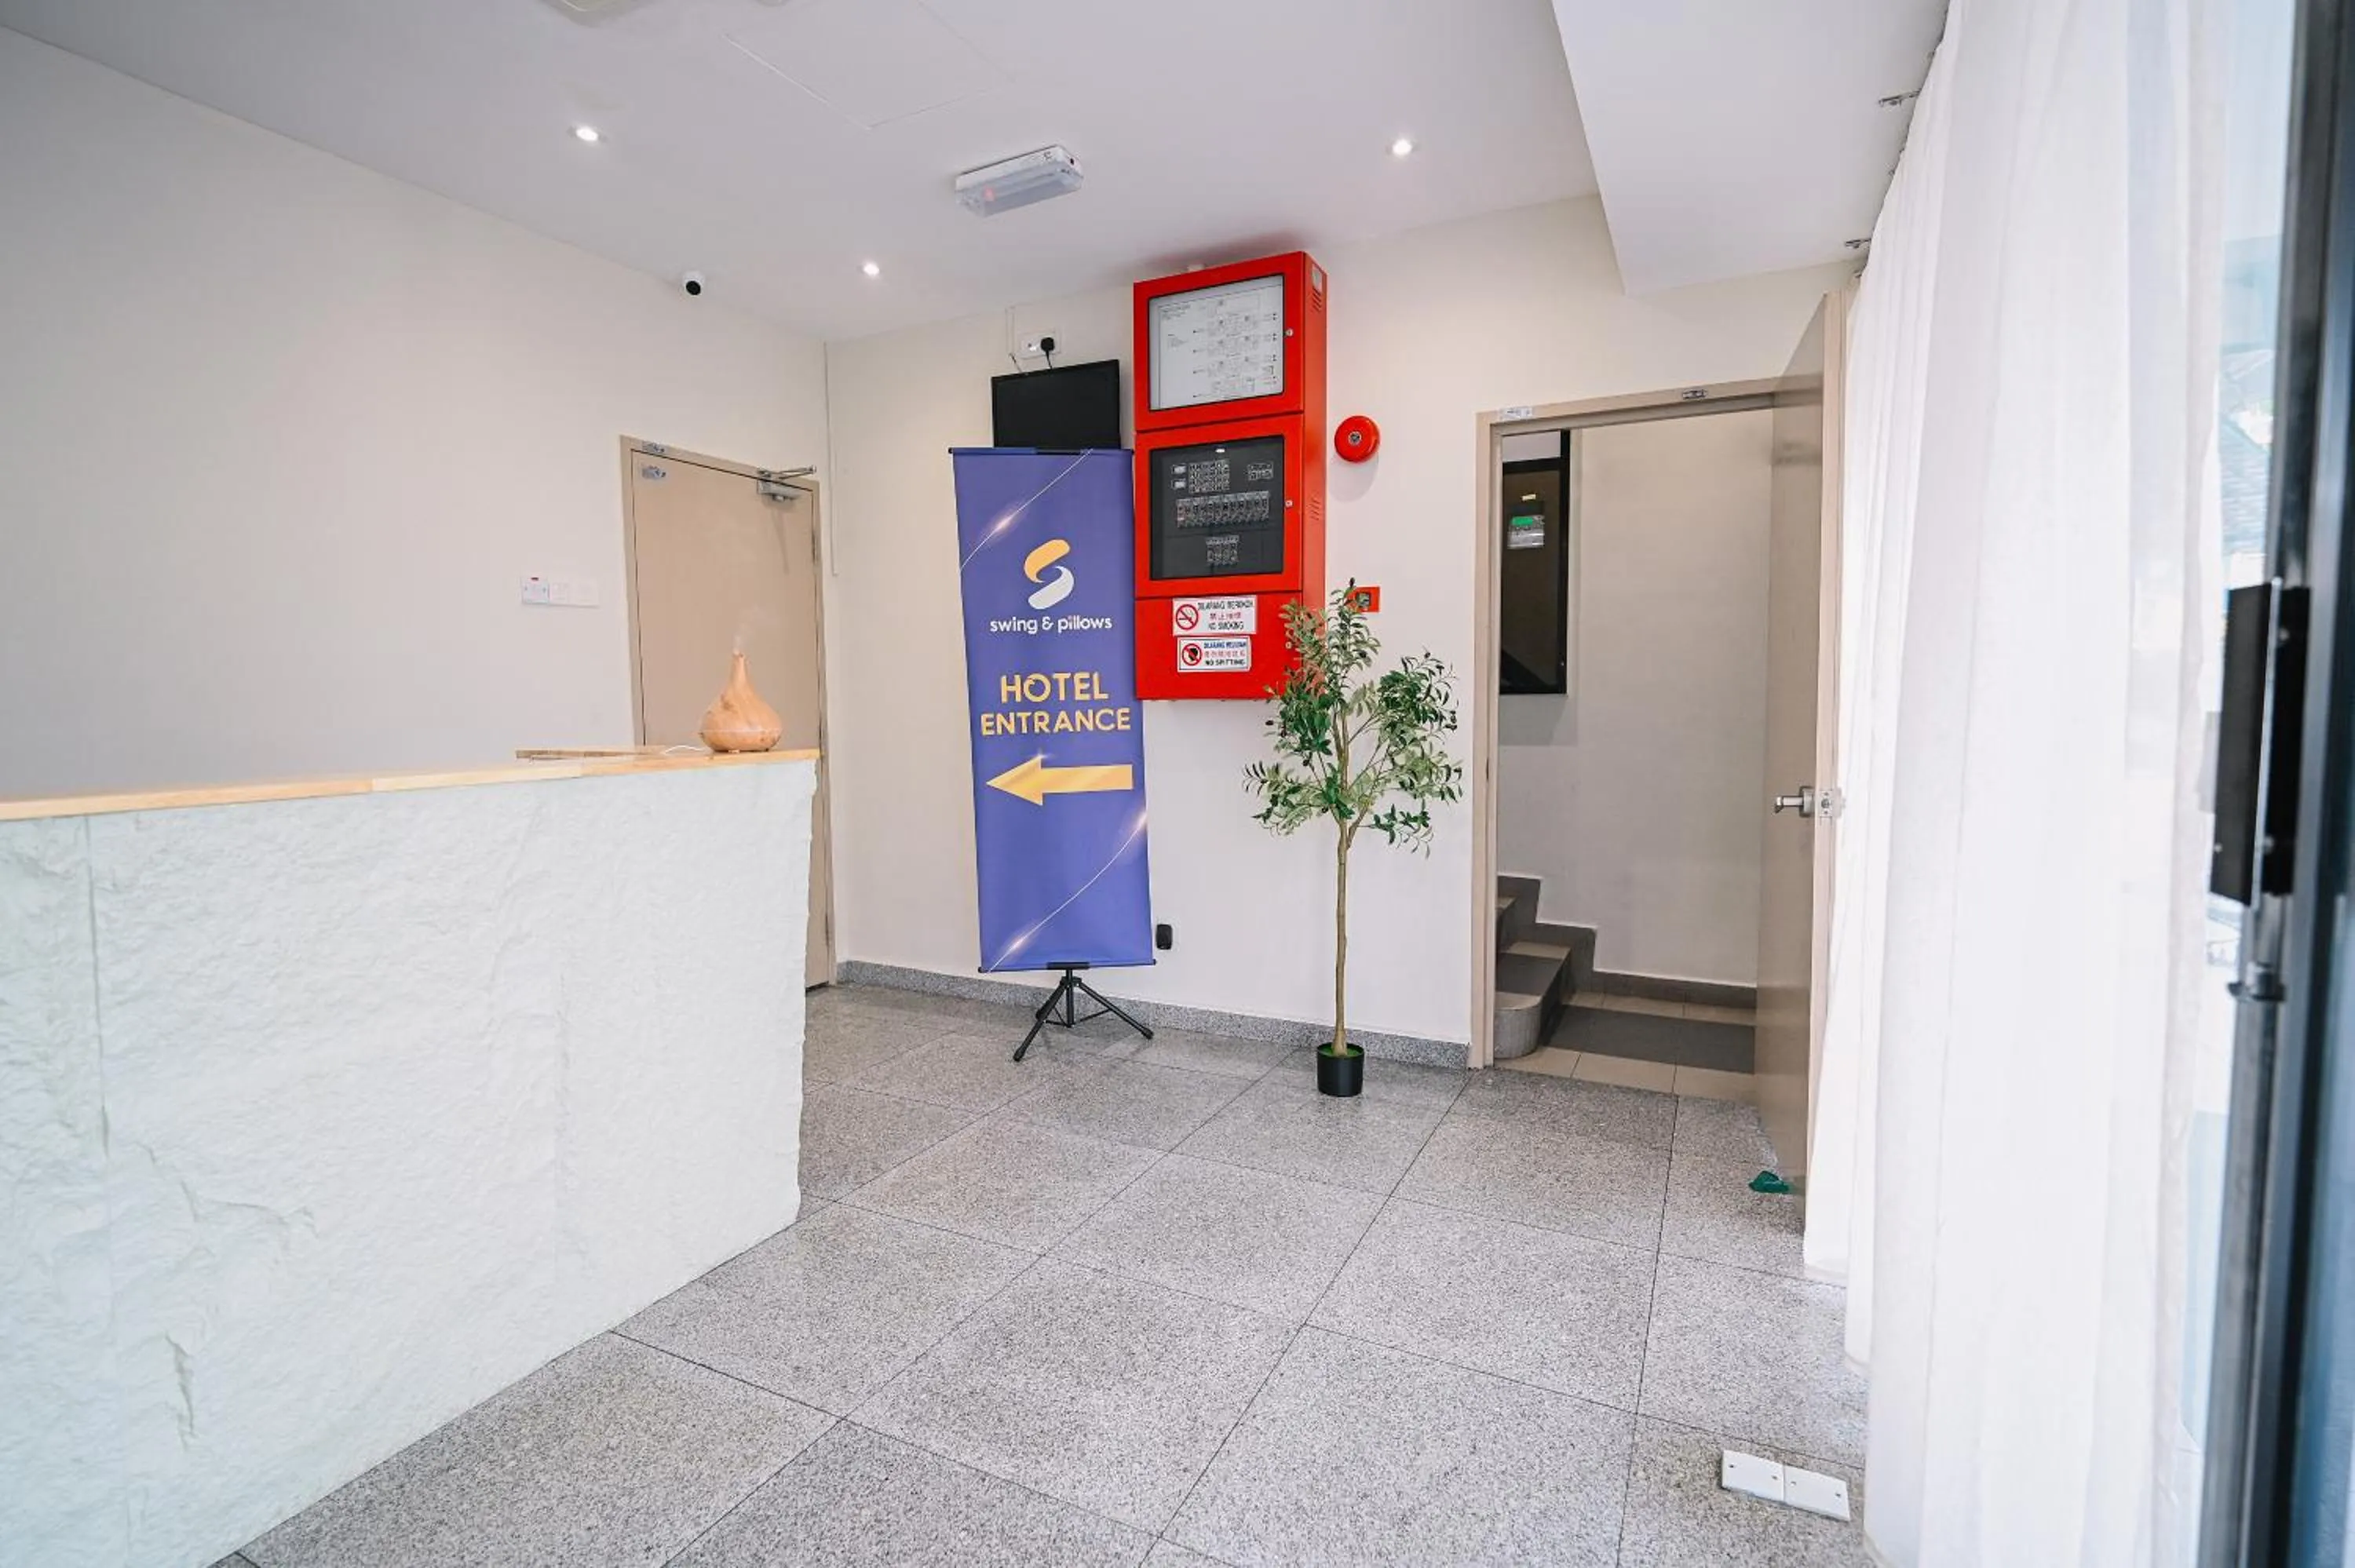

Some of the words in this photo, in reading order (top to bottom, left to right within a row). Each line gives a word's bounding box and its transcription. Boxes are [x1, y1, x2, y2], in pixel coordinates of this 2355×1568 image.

[990, 617, 1038, 634] swing
[1042, 616, 1053, 630] &
[1058, 615, 1112, 633] pillows
[1001, 672, 1109, 703] HOTEL
[981, 708, 1131, 736] ENTRANCE
